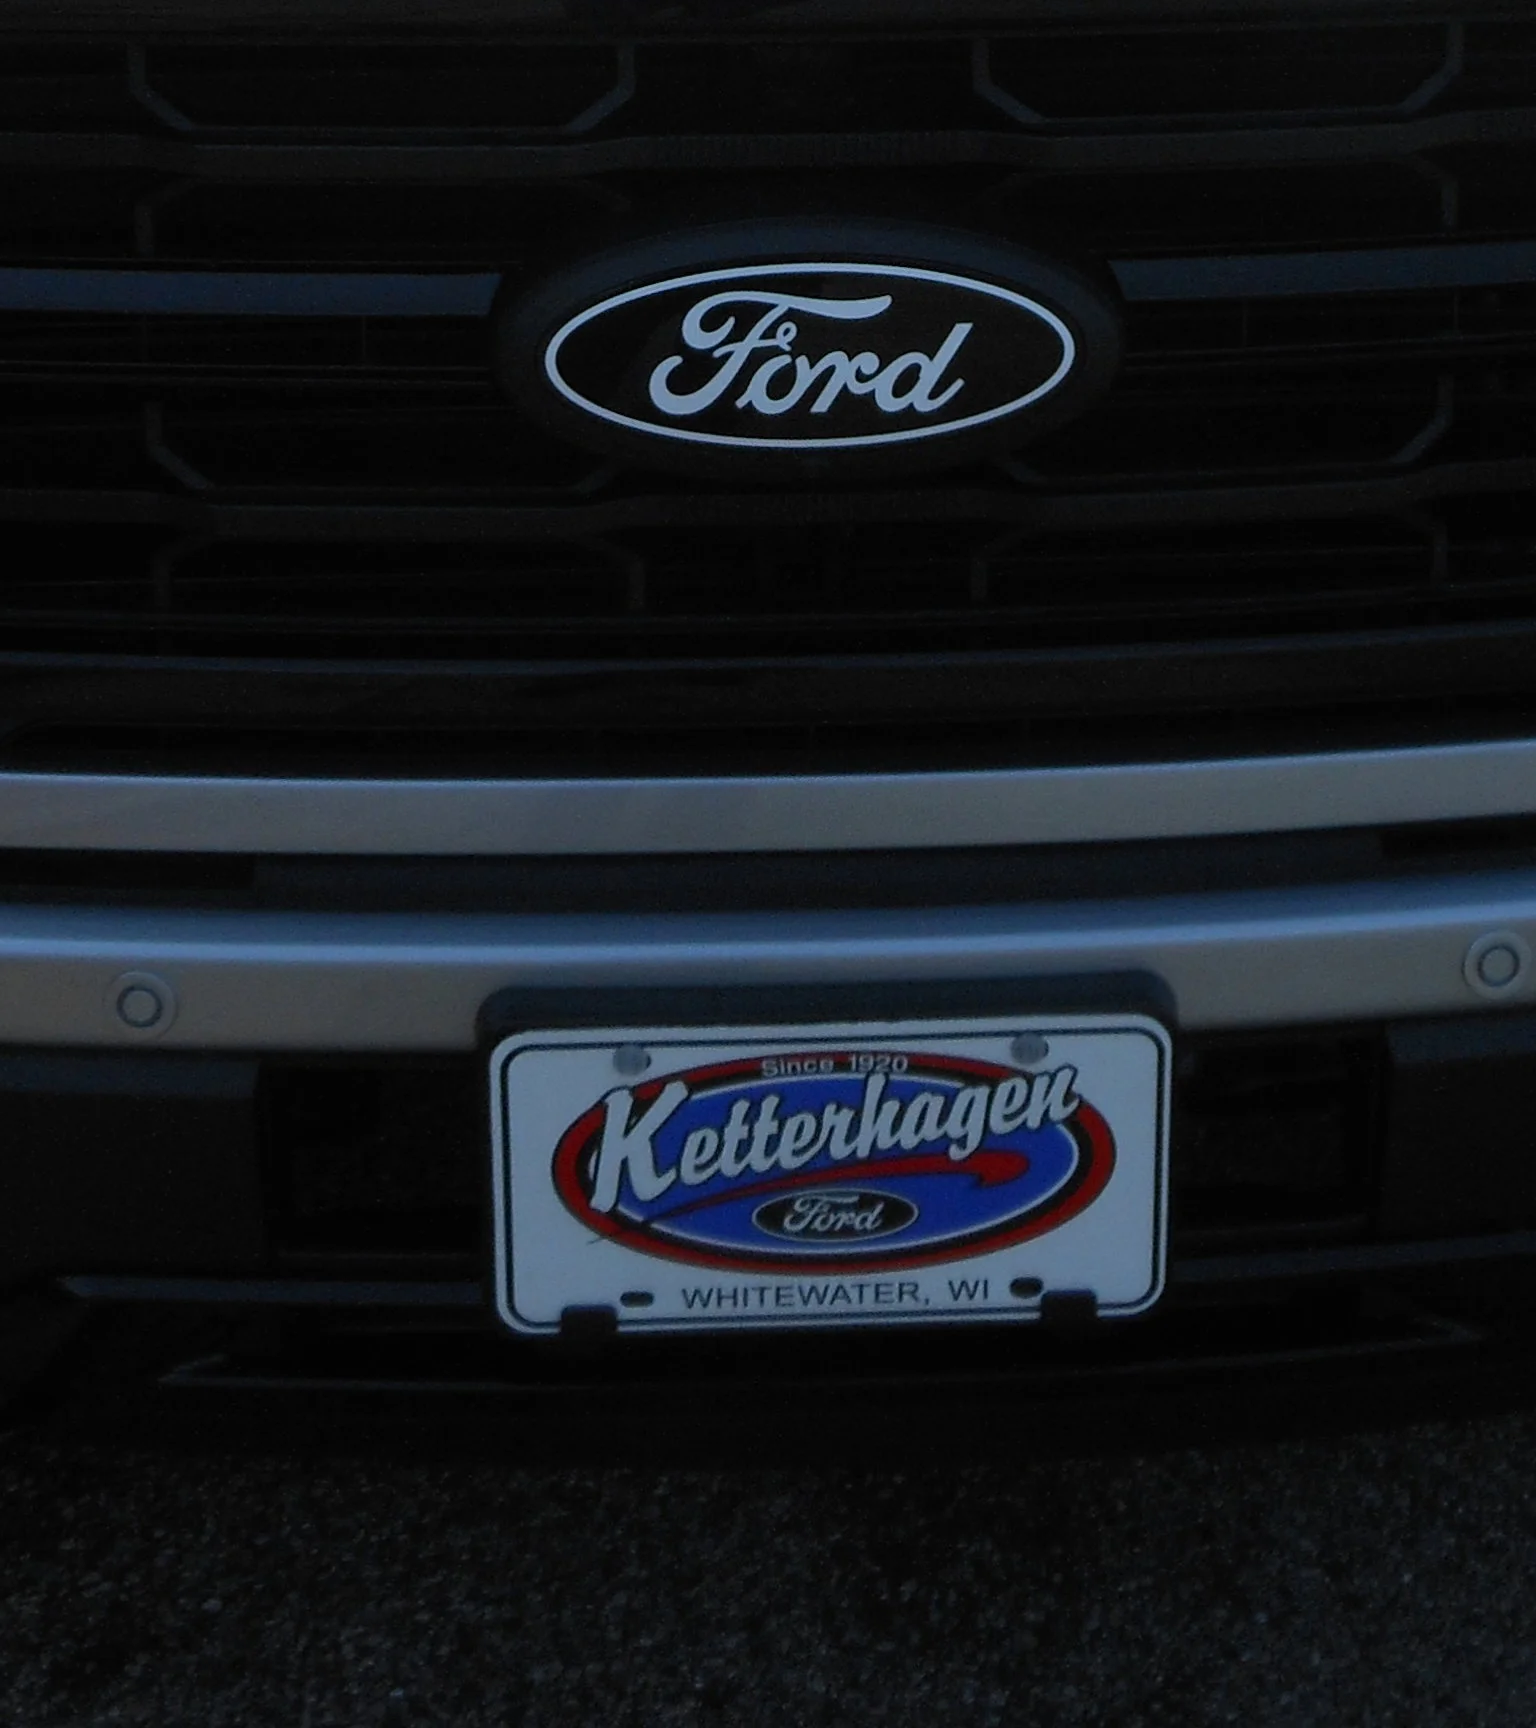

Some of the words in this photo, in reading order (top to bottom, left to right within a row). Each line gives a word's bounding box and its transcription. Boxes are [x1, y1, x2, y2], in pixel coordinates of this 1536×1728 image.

[649, 290, 974, 415] Ford
[762, 1057, 834, 1077] Since
[848, 1052, 909, 1073] 1920
[589, 1064, 1081, 1212] Ketterhagen
[782, 1194, 886, 1233] Ford
[681, 1281, 931, 1309] WHITEWATER,
[947, 1278, 990, 1302] WI
